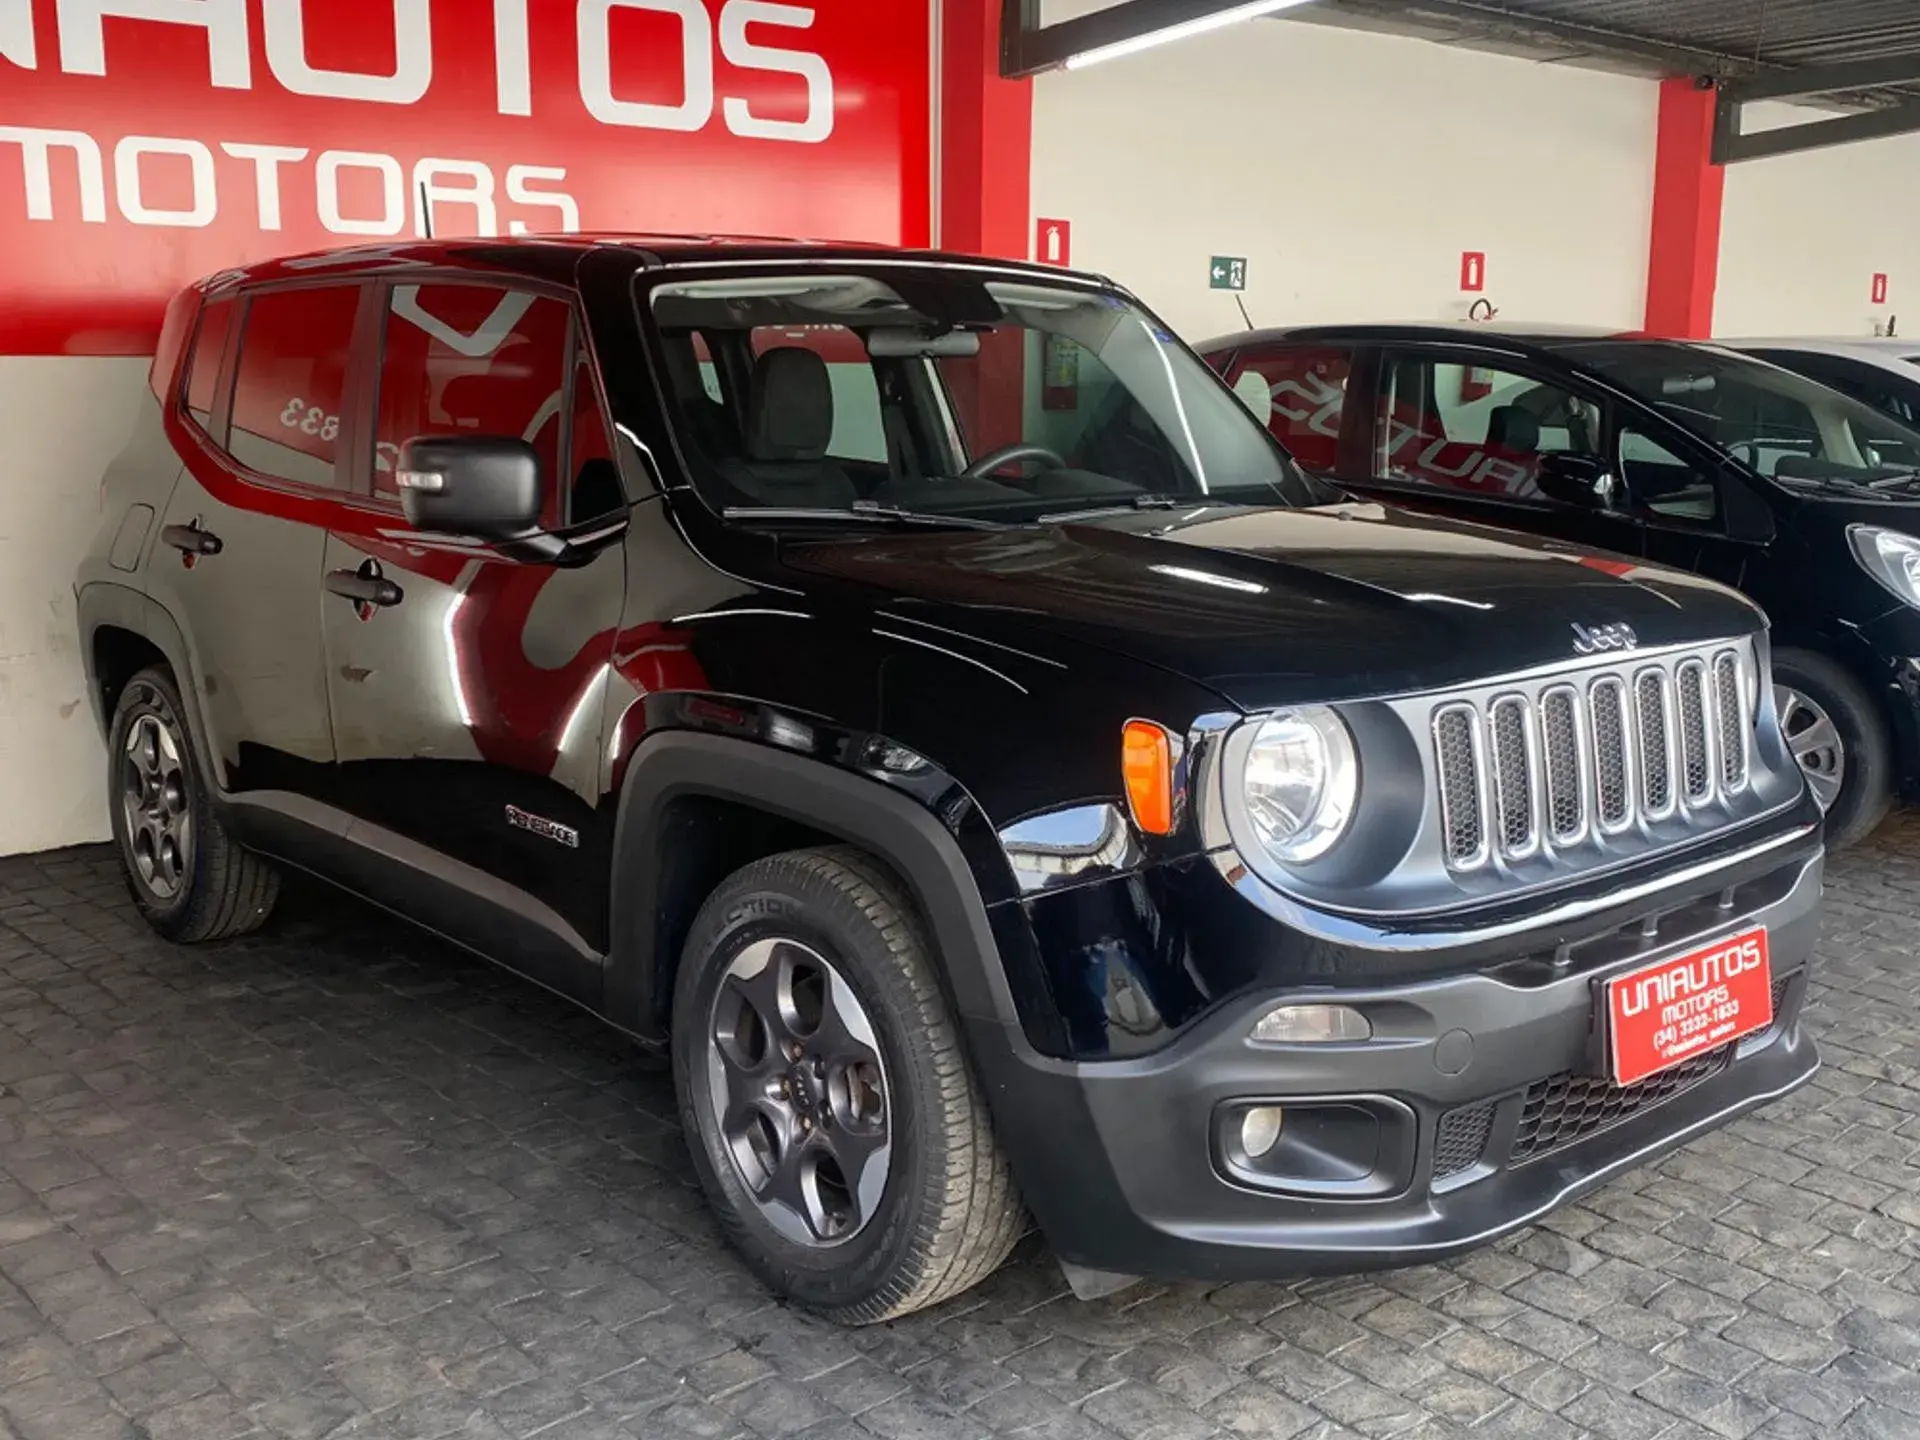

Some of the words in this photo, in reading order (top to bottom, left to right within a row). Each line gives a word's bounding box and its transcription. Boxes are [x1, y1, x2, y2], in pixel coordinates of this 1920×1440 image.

[0, 126, 579, 239] MOTORS
[1570, 621, 1637, 653] Jeep
[1621, 939, 1761, 1018] UNIAUTOS
[1662, 984, 1730, 1026] MOTORS
[1653, 1025, 1678, 1051] (34)
